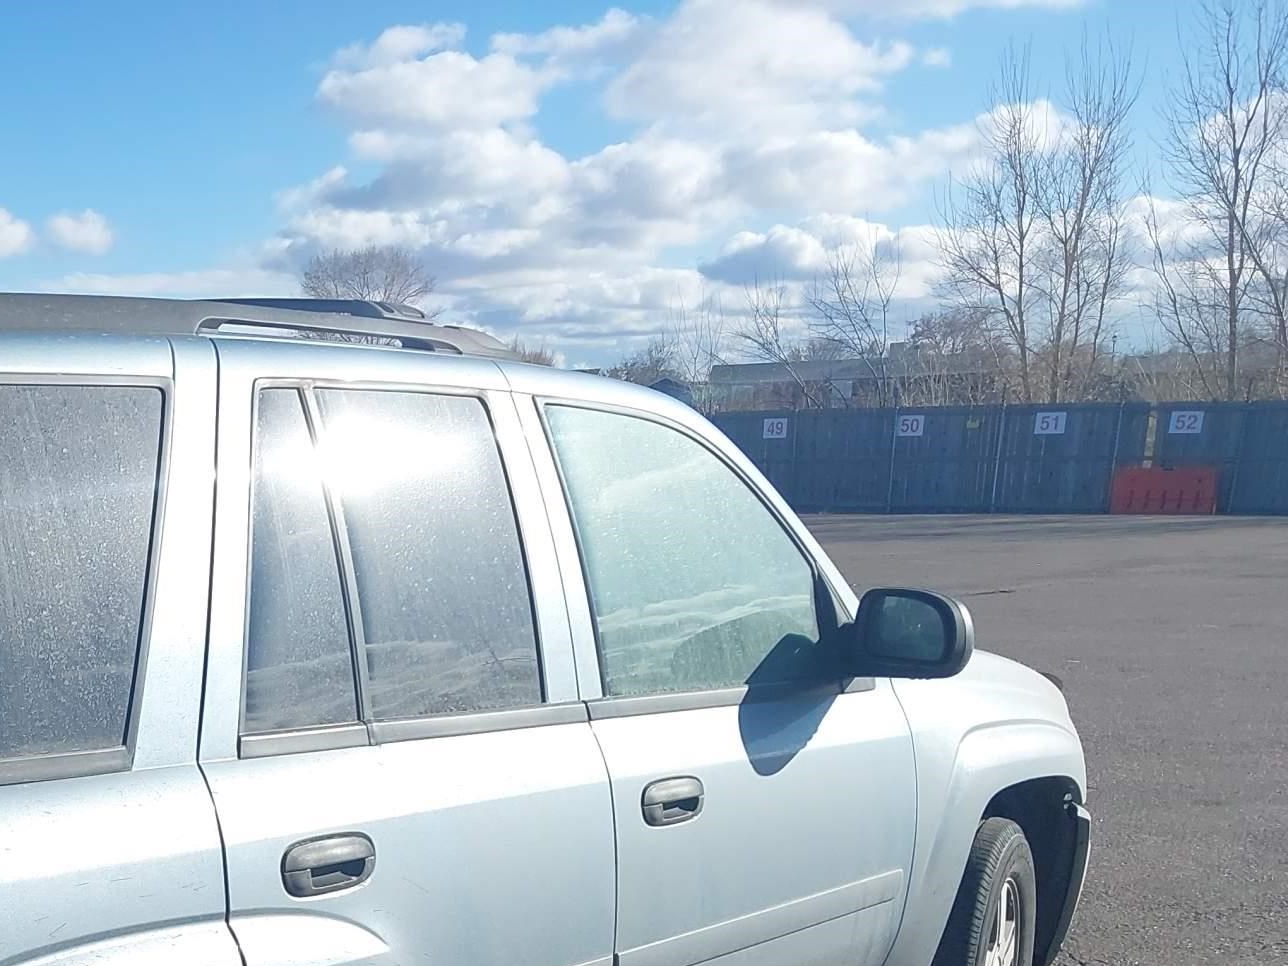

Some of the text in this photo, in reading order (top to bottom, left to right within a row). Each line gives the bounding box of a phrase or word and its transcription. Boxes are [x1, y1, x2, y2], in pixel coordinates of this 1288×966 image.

[766, 421, 785, 436] 49
[900, 418, 921, 433] 50
[1039, 416, 1059, 431] 51
[1175, 416, 1198, 430] 52
